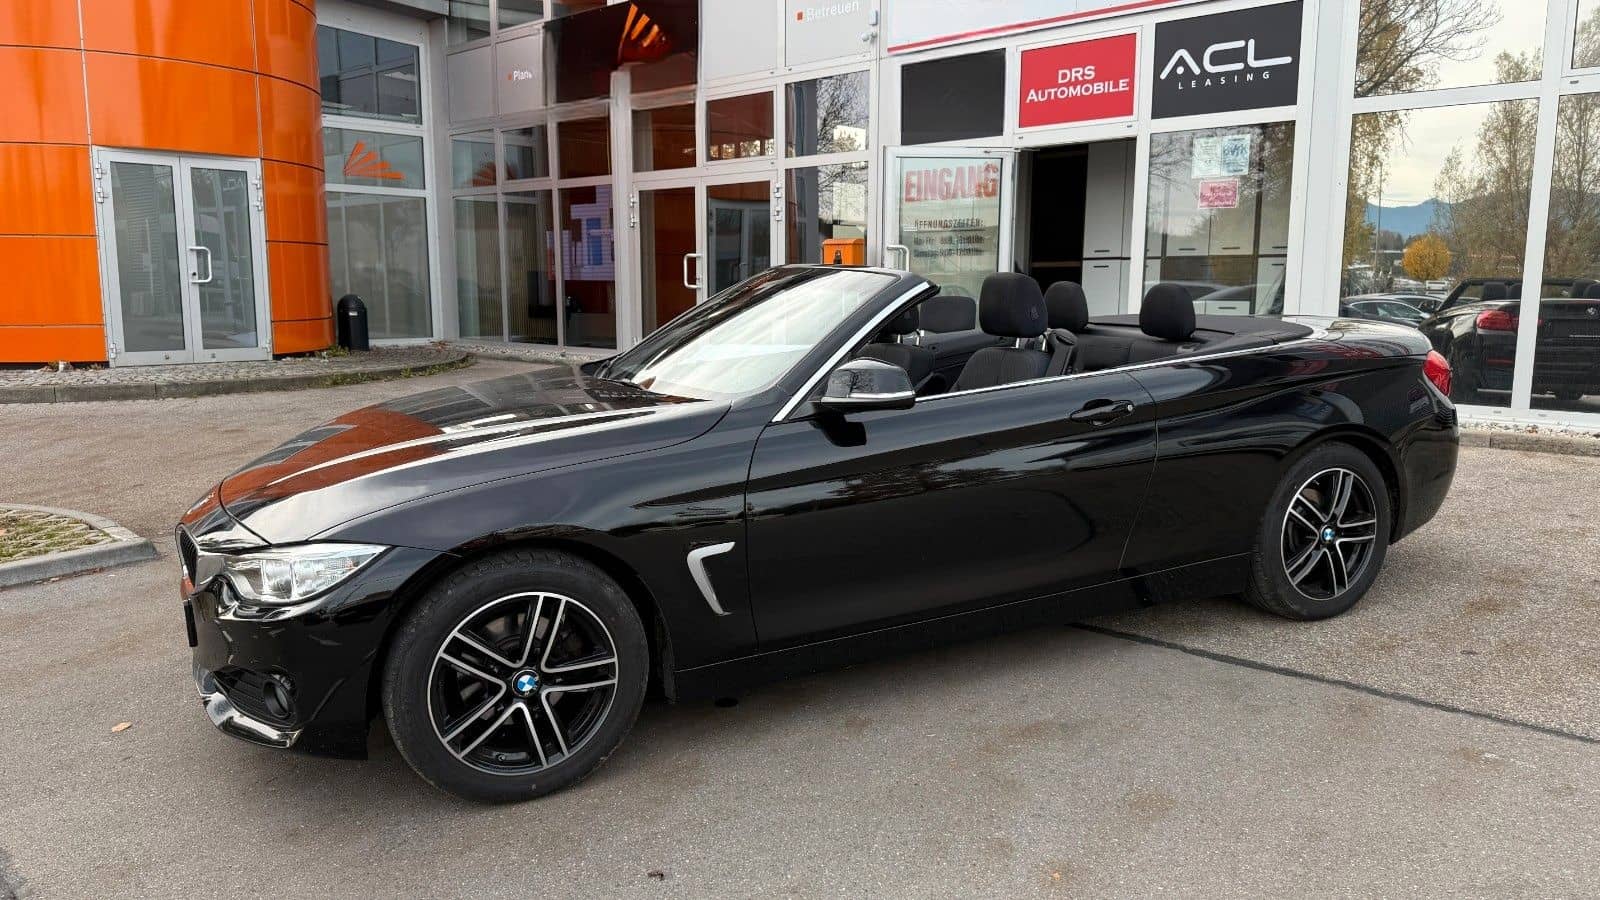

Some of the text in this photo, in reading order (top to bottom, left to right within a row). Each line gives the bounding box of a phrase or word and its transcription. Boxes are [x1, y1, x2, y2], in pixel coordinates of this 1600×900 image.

[1160, 38, 1292, 80] ACL
[1057, 65, 1096, 84] DRS
[1178, 71, 1270, 90] LEASING
[1025, 78, 1130, 103] AUTOMOBILE
[904, 161, 999, 202] EINGANG
